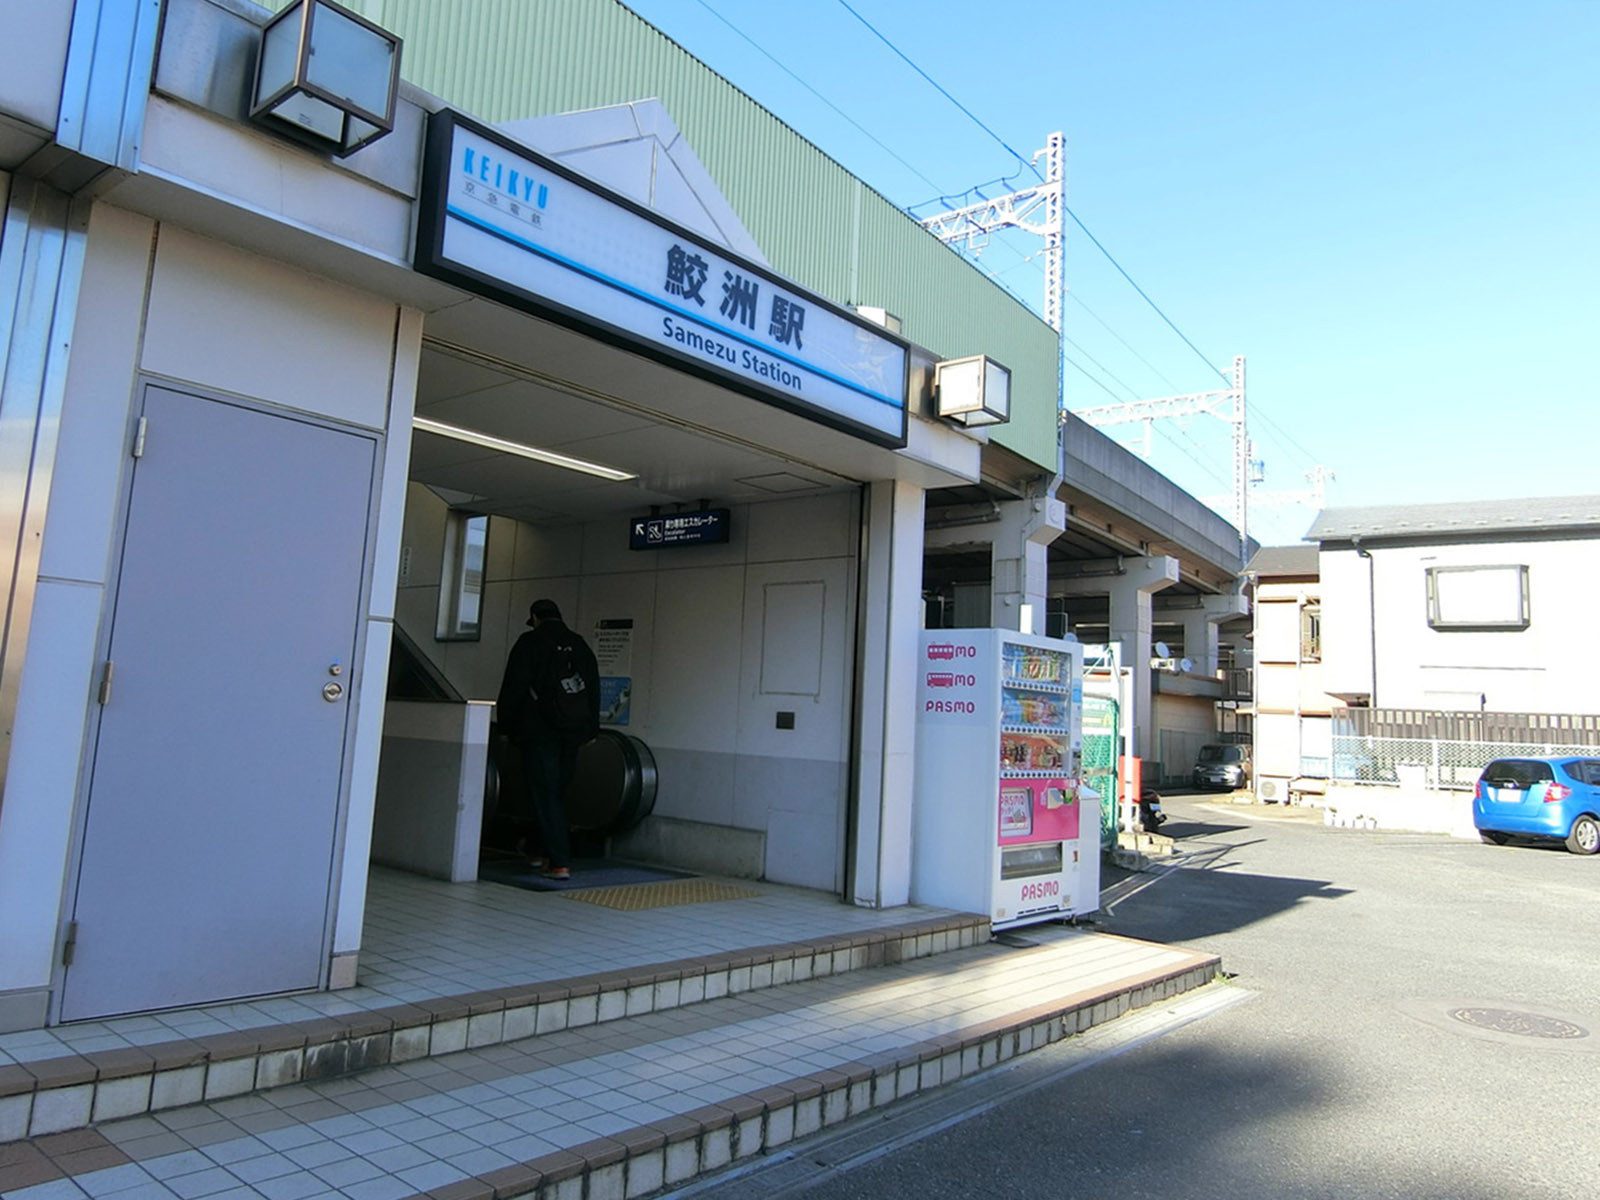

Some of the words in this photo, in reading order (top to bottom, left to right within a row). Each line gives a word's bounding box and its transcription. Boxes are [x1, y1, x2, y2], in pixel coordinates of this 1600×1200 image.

[464, 147, 548, 210] KEIKYU
[664, 244, 806, 351] 鮫洲駅
[662, 317, 736, 364] Samezu
[742, 350, 802, 390] Station
[925, 700, 976, 714] PASMO
[1021, 881, 1060, 902] PASMO
